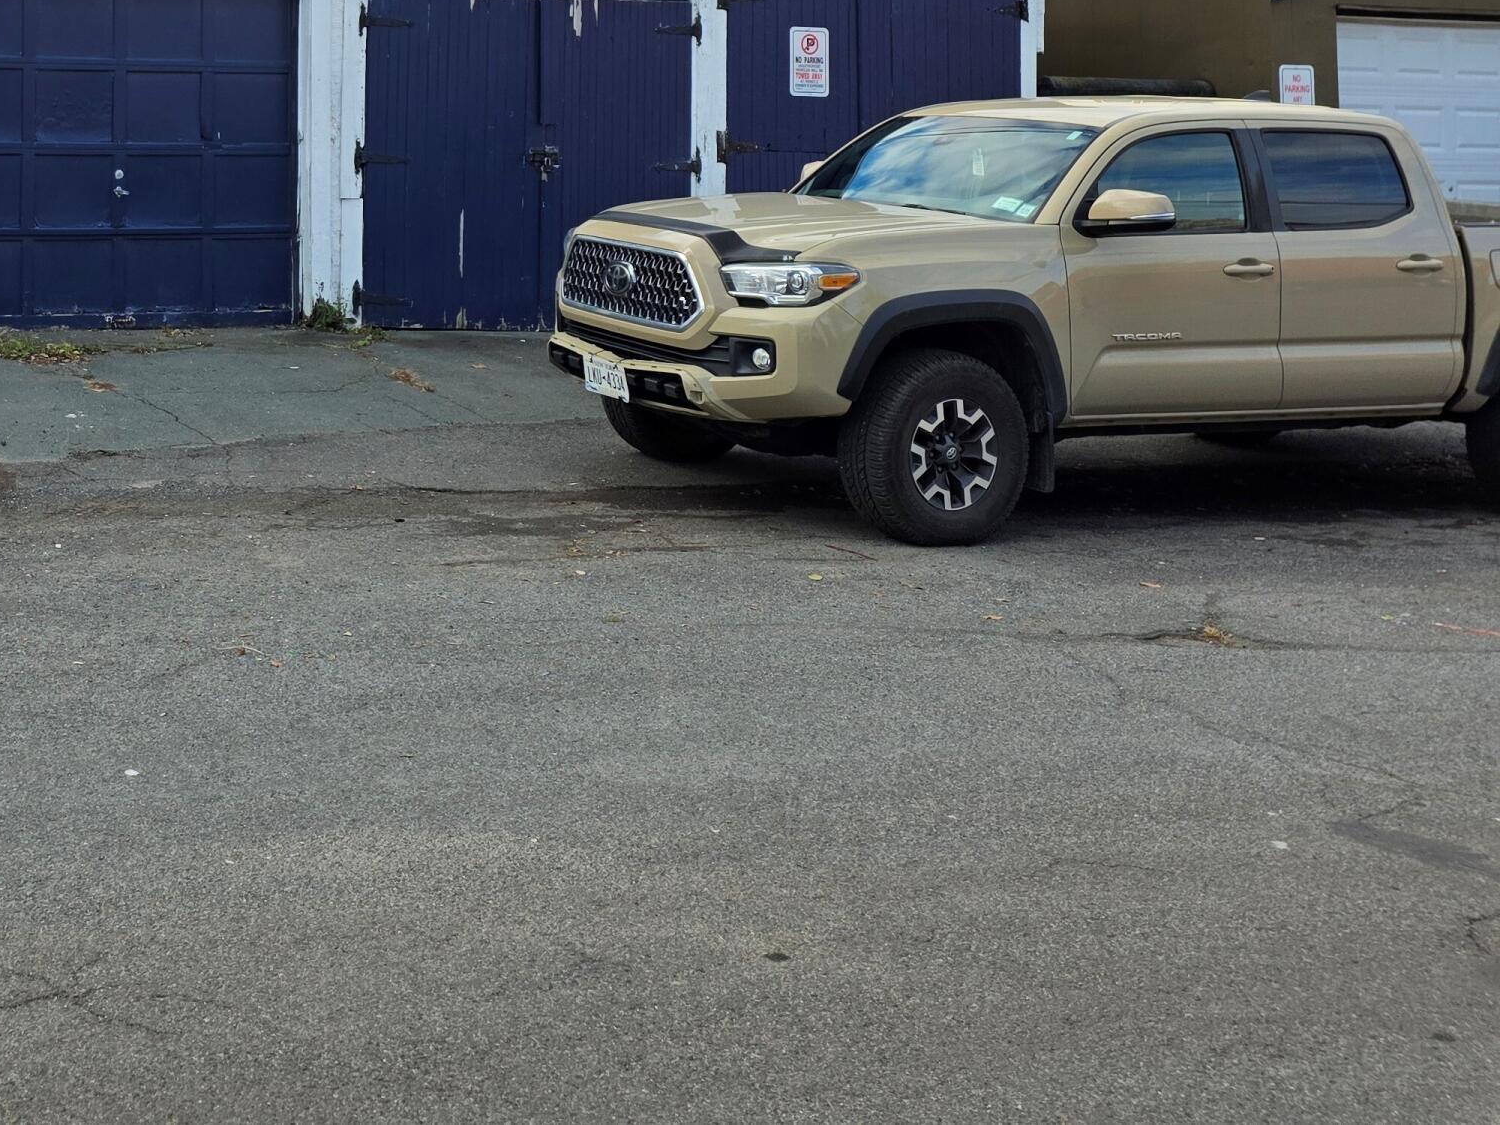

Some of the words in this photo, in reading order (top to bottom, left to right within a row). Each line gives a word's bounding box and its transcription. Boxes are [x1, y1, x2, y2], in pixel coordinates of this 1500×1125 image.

[796, 56, 802, 64] NO
[804, 56, 824, 65] PARKING
[1292, 74, 1301, 83] NO
[1284, 84, 1310, 93] PARKING
[1111, 332, 1182, 341] TACOMA
